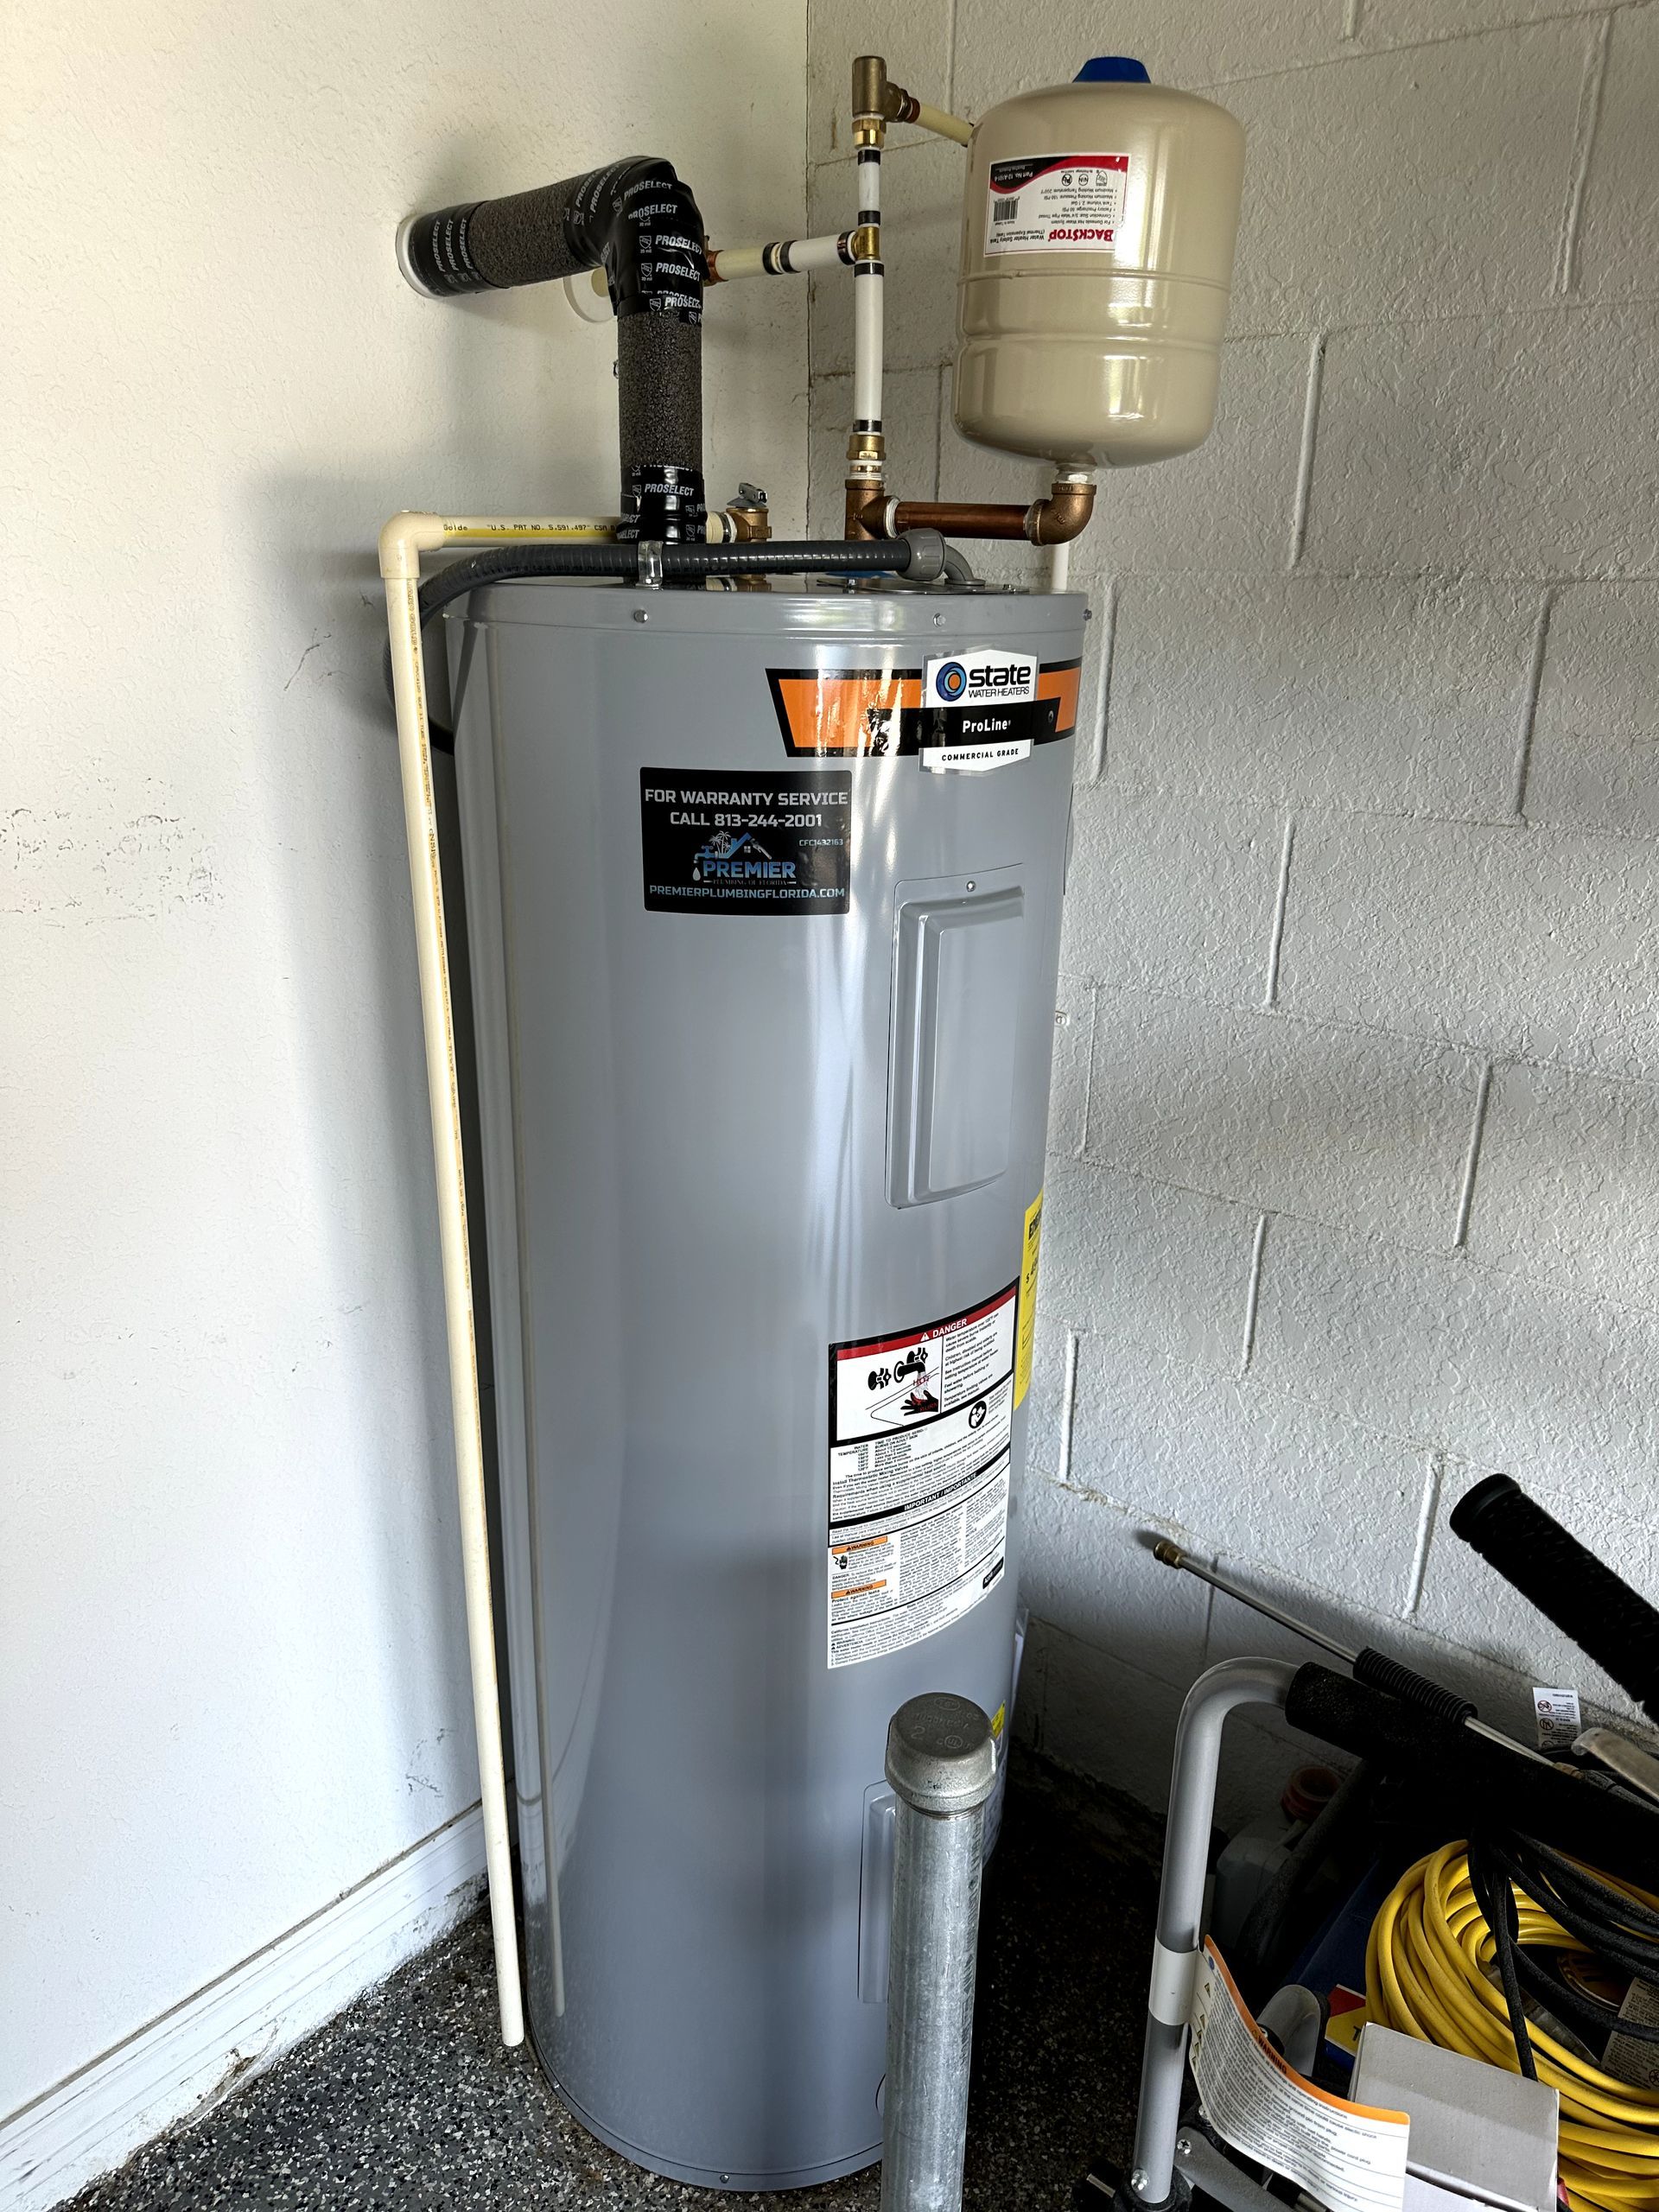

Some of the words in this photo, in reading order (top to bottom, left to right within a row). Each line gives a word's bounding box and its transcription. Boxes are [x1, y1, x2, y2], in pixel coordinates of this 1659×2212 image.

[623, 180, 672, 200] PROSELECT
[432, 219, 446, 273] PROSELECT
[445, 218, 460, 271] PROSELECT
[459, 217, 474, 270] PROSELECT
[655, 234, 702, 255] PROSELECT
[655, 262, 701, 282] PROSELECT
[644, 483, 695, 496] PROSELECT
[969, 664, 1031, 688] state
[969, 689, 997, 698] WATER
[997, 686, 1029, 696] HEATERS
[942, 751, 994, 761] COMMERCIAL
[997, 748, 1019, 757] GRADE
[645, 789, 676, 804] FOR
[681, 791, 773, 805] WARRANTY
[778, 791, 849, 806] SERVICE
[670, 812, 710, 826] CALL
[715, 814, 822, 828] 813-244-2001
[703, 861, 797, 879] PREMIER
[649, 885, 845, 899] PREMIERPLUMBINGFLORIDA.COM
[932, 1319, 967, 1338] DANGER
[904, 1492, 940, 1510] IMPORTANT
[944, 1471, 976, 1494] IMPORTANTE
[1258, 2035, 1287, 2075] WARNING
